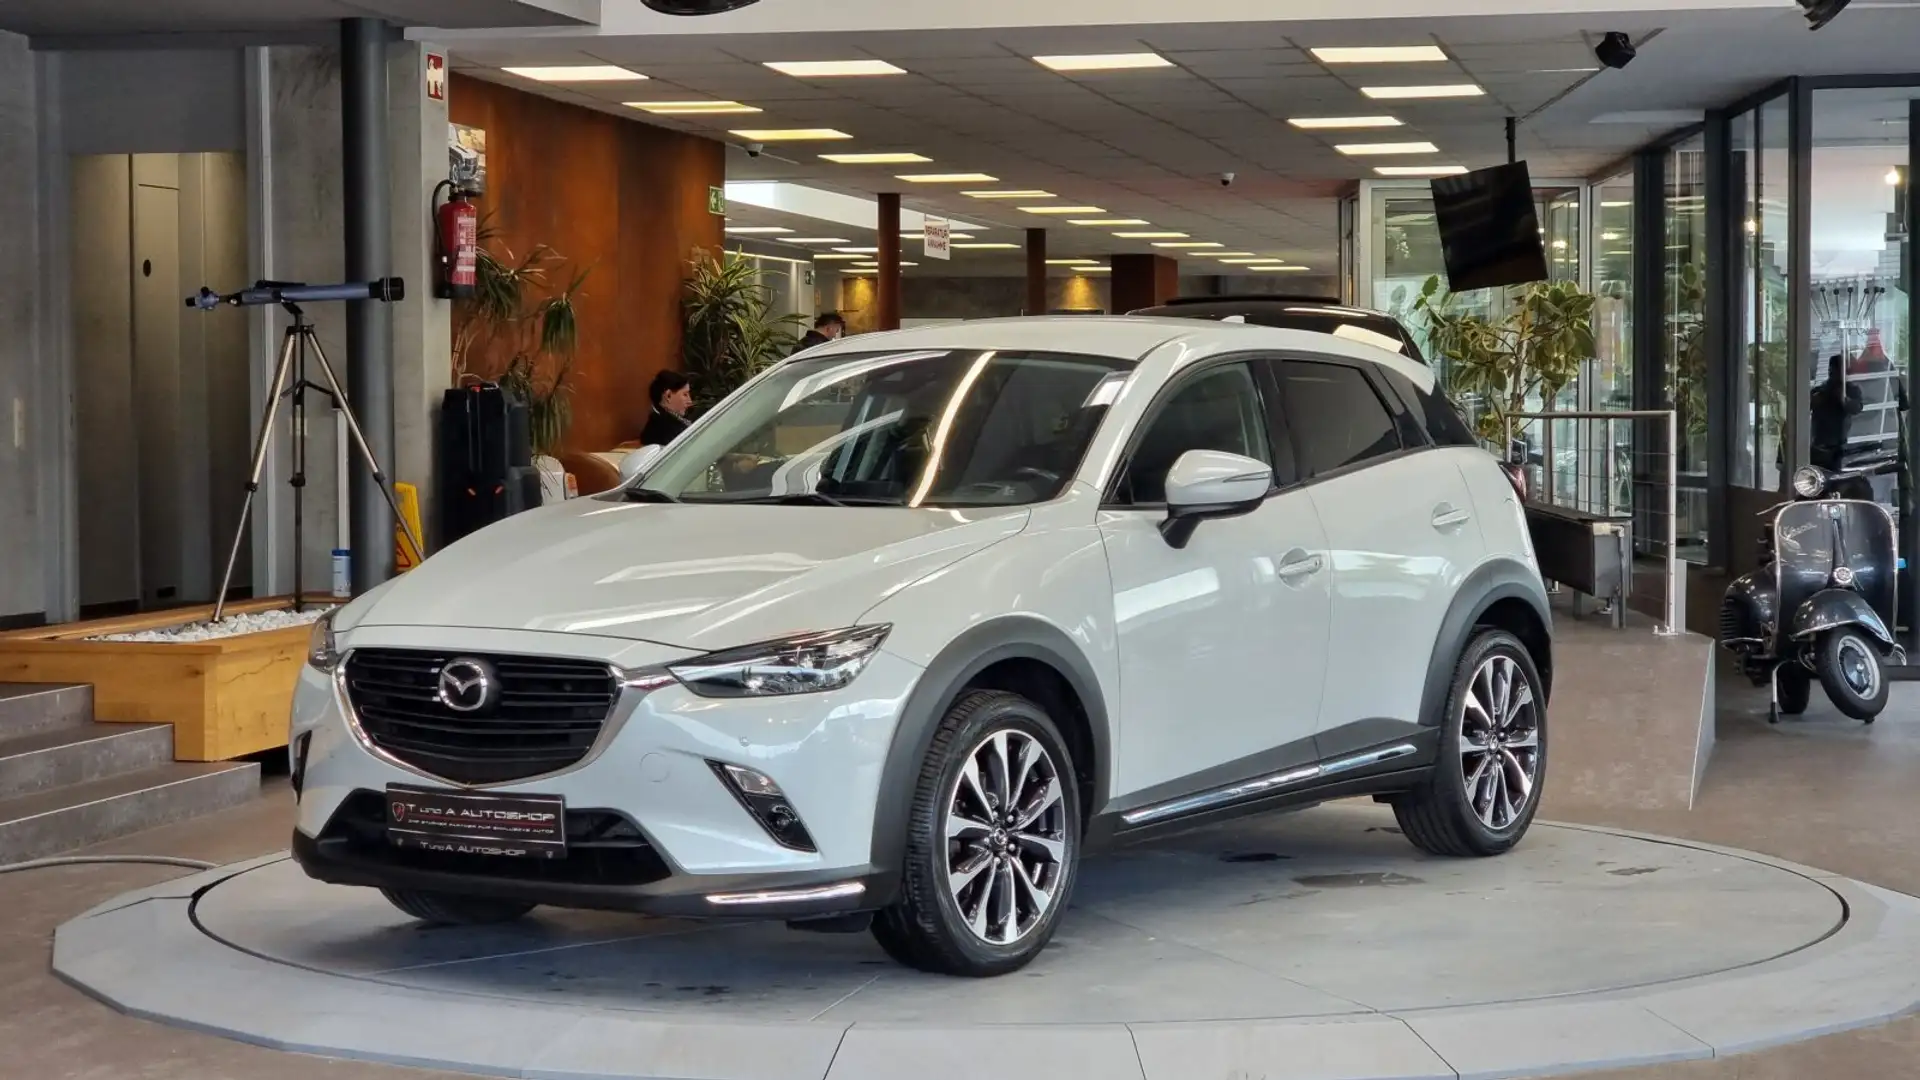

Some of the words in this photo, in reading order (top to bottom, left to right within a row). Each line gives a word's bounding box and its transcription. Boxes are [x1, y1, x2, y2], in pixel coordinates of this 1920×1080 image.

[405, 803, 416, 812] T
[445, 808, 456, 816] A
[460, 809, 555, 821] AUTOSHOP
[445, 844, 454, 852] A
[457, 845, 526, 856] AUTOSHOP
